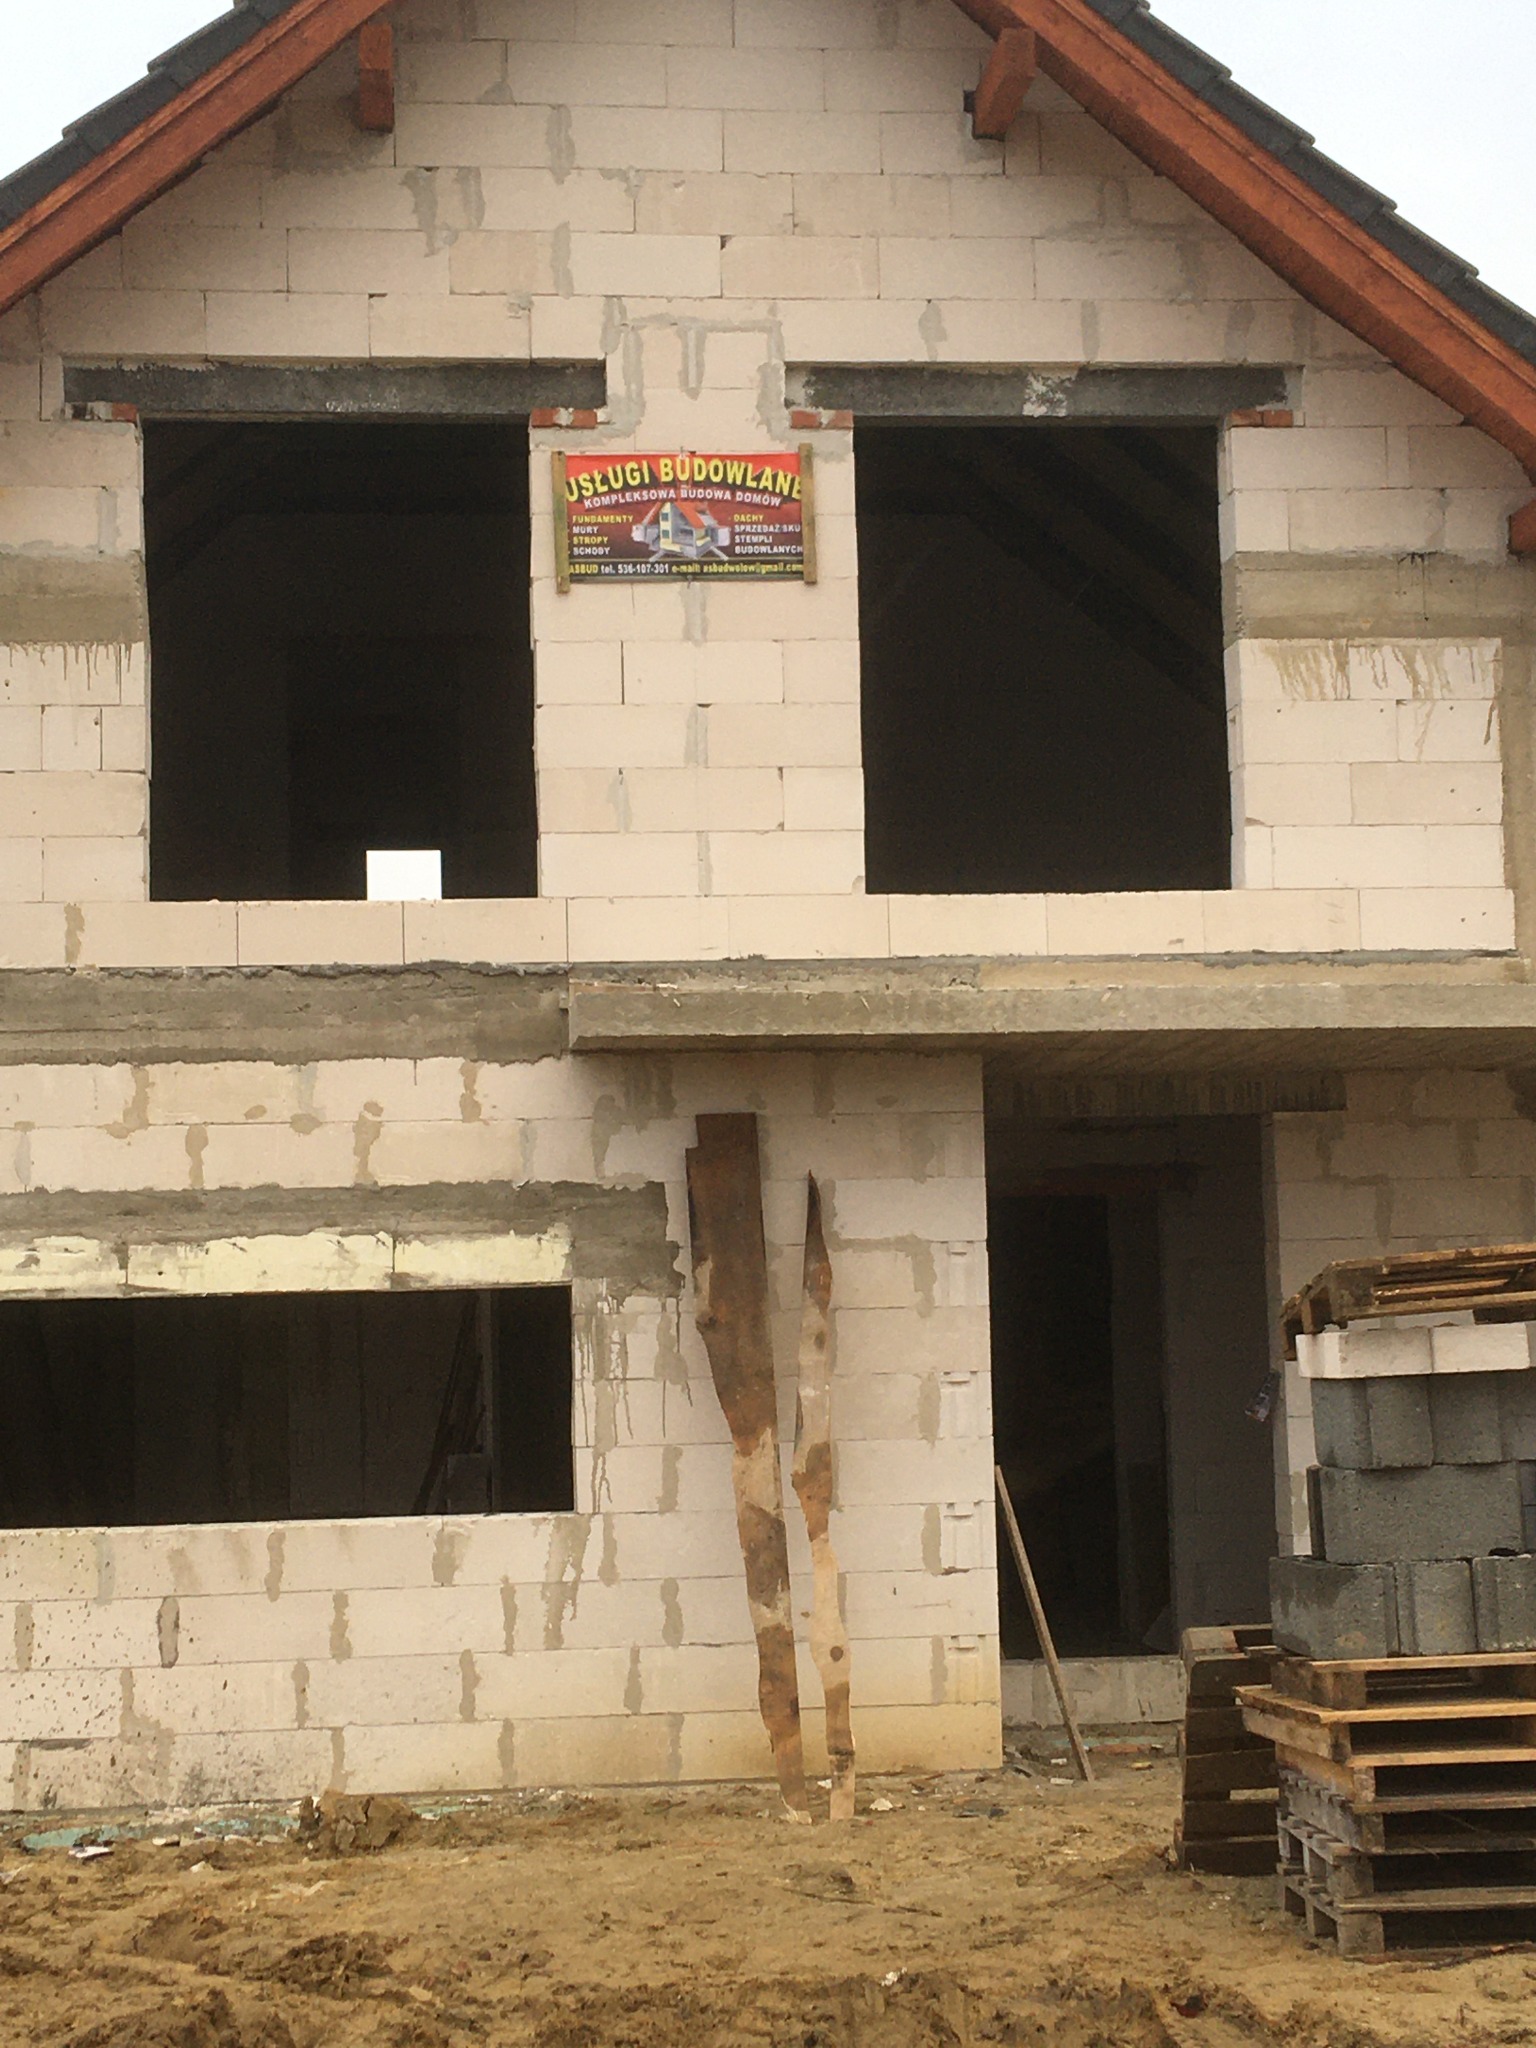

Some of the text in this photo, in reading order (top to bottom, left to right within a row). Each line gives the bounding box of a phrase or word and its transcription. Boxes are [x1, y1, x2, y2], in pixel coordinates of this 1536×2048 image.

[566, 460, 650, 502] USŁUGI
[583, 489, 782, 509] KOMPLEKSOWA BUDOWA DOMÓW
[572, 515, 634, 524] FUNDAMENTY
[733, 514, 764, 522] DACHY
[572, 526, 599, 534] MURY
[573, 536, 608, 545] STROPY
[734, 535, 773, 543] STEMPLI
[573, 547, 611, 556] SCHODY
[734, 545, 804, 554] BUDOWLANYCH
[600, 563, 616, 574] tel.
[617, 563, 669, 574] 536-107-301
